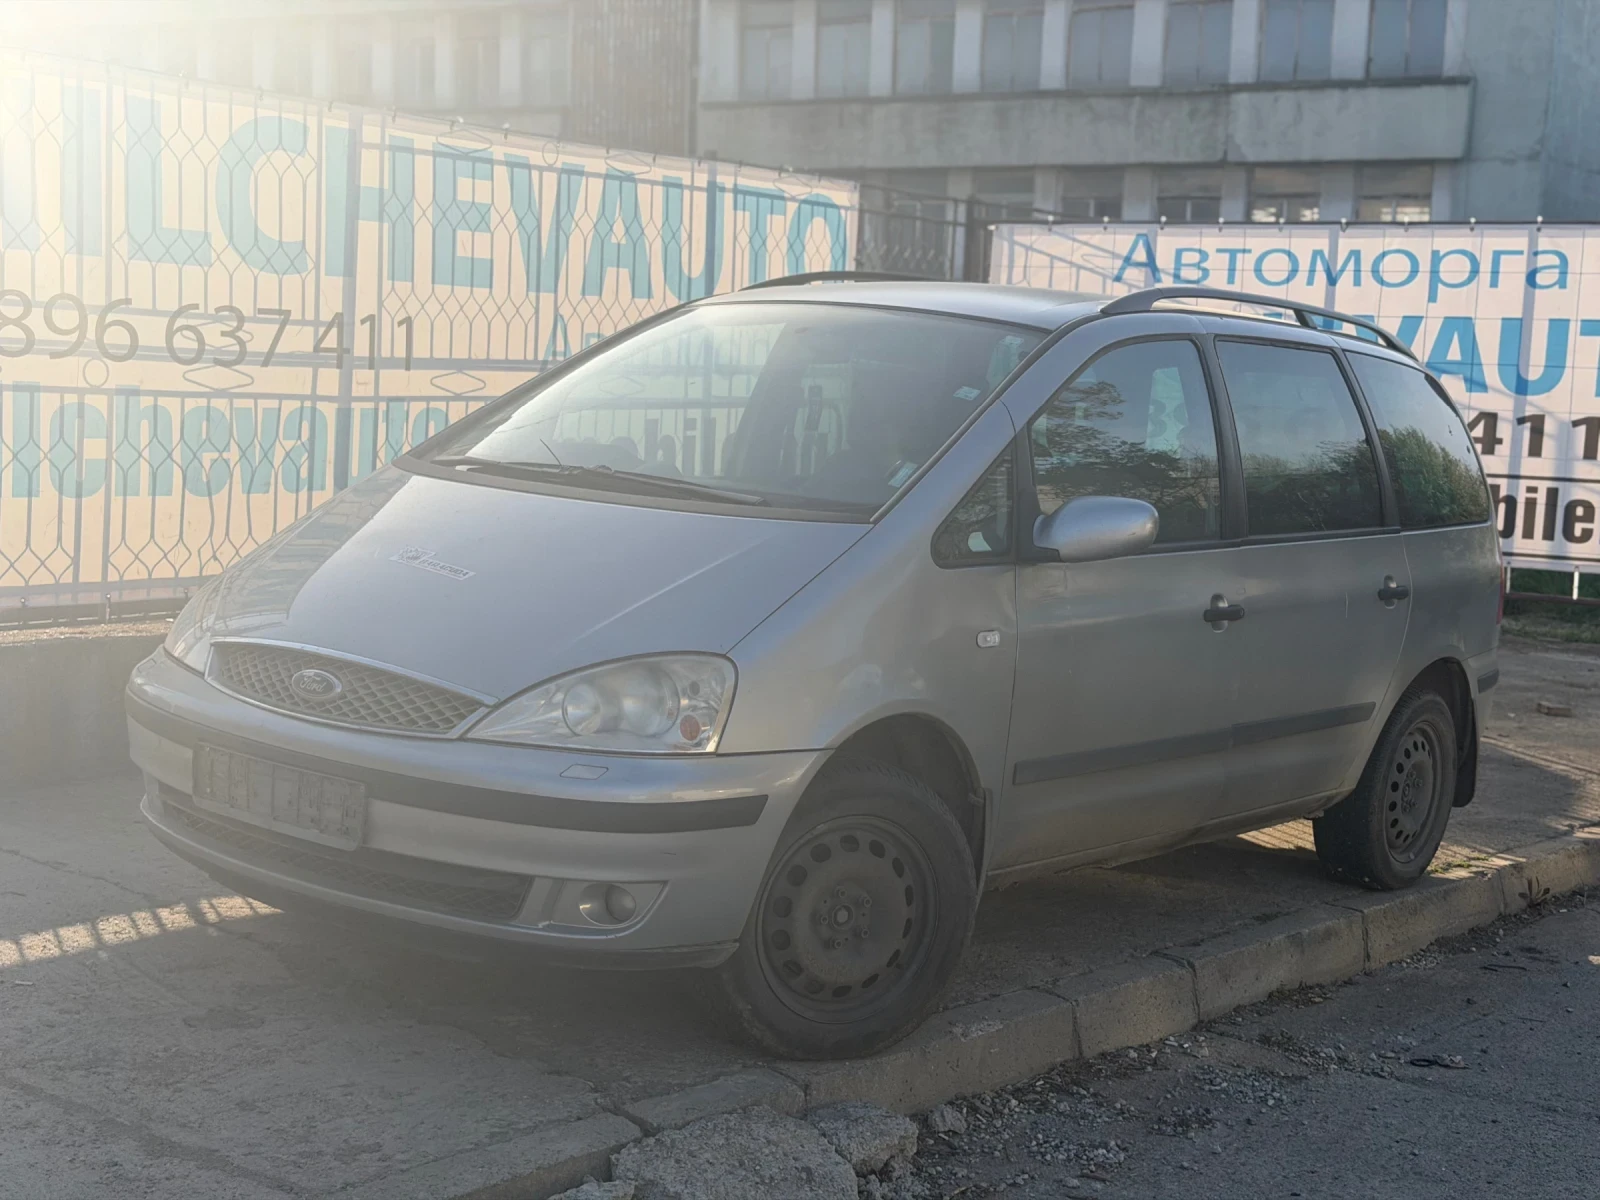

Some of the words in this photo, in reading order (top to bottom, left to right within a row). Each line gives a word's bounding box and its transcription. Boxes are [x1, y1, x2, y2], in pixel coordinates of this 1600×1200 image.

[1112, 233, 1568, 303] Автоморга
[165, 303, 292, 369] 637
[313, 311, 414, 372] 411
[300, 675, 328, 692] Ford
